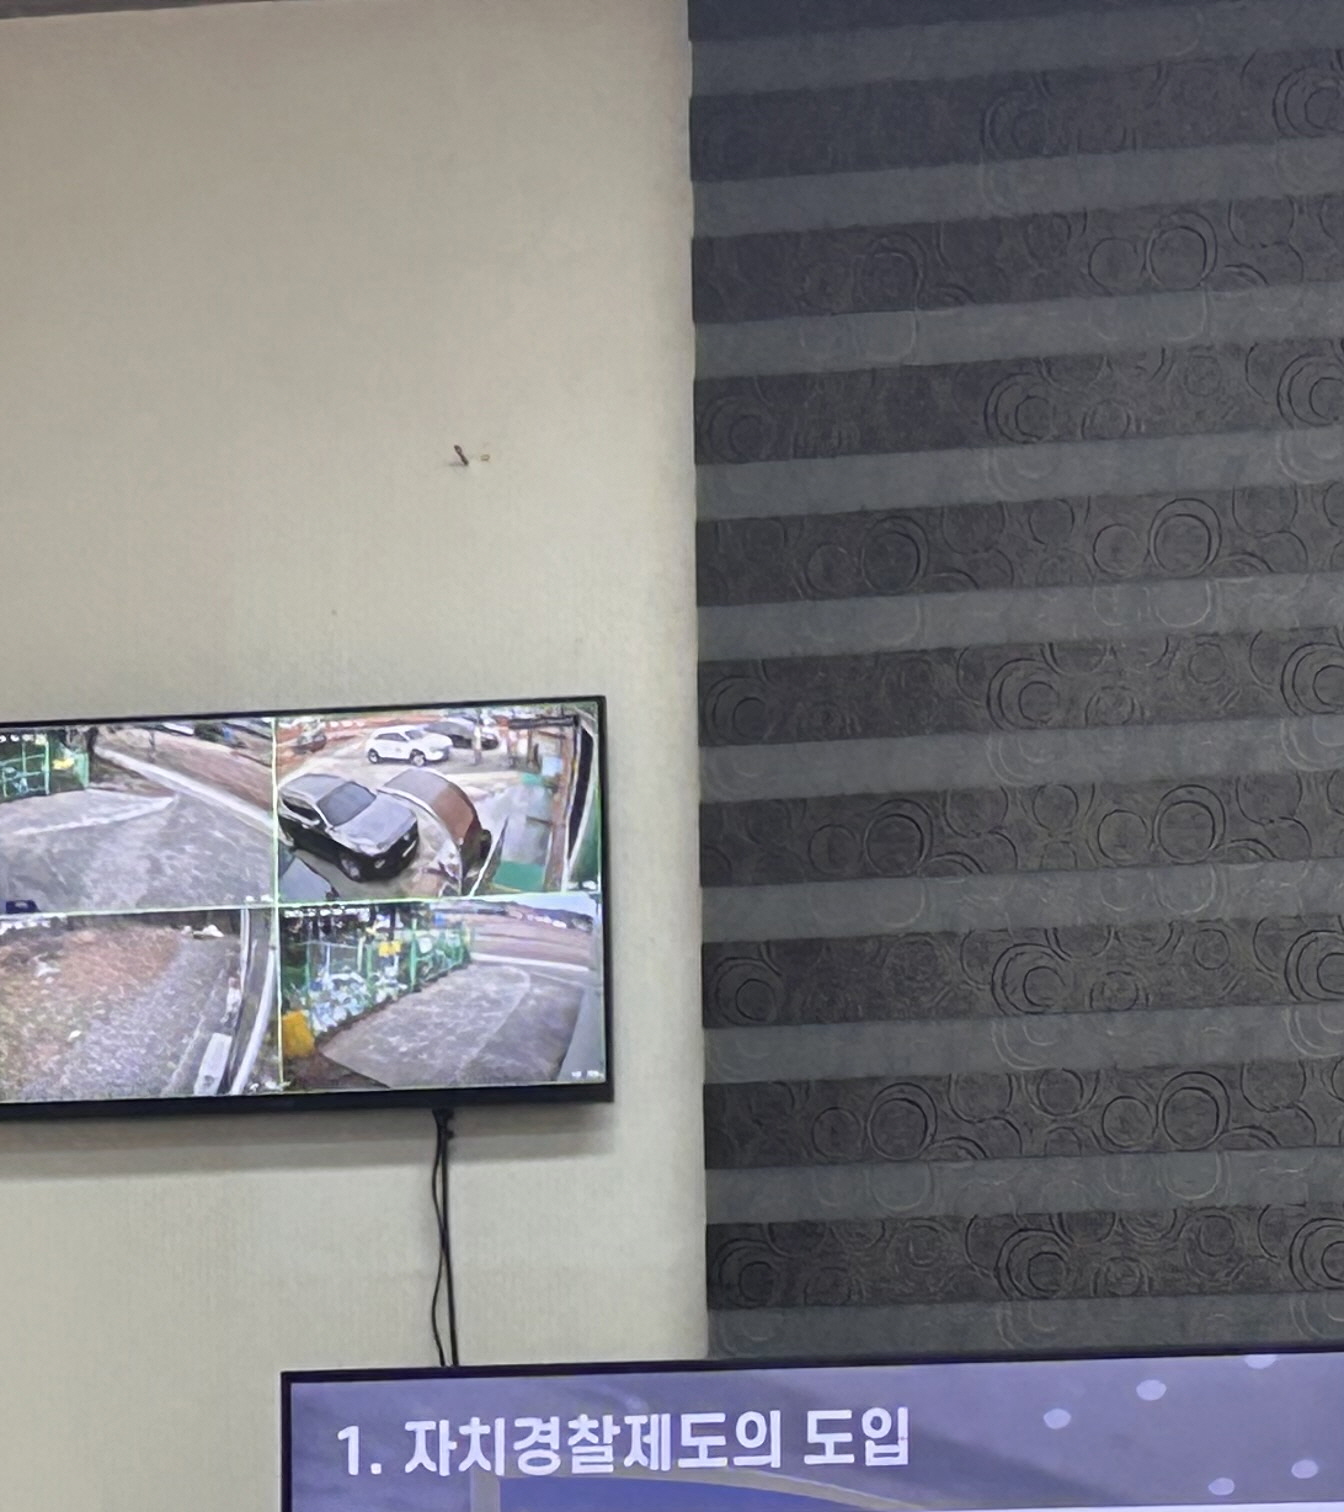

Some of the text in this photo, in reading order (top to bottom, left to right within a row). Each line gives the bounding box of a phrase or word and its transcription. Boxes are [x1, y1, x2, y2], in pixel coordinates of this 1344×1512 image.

[337, 1406, 910, 1478] 1. 자치경찰제도의 도입
